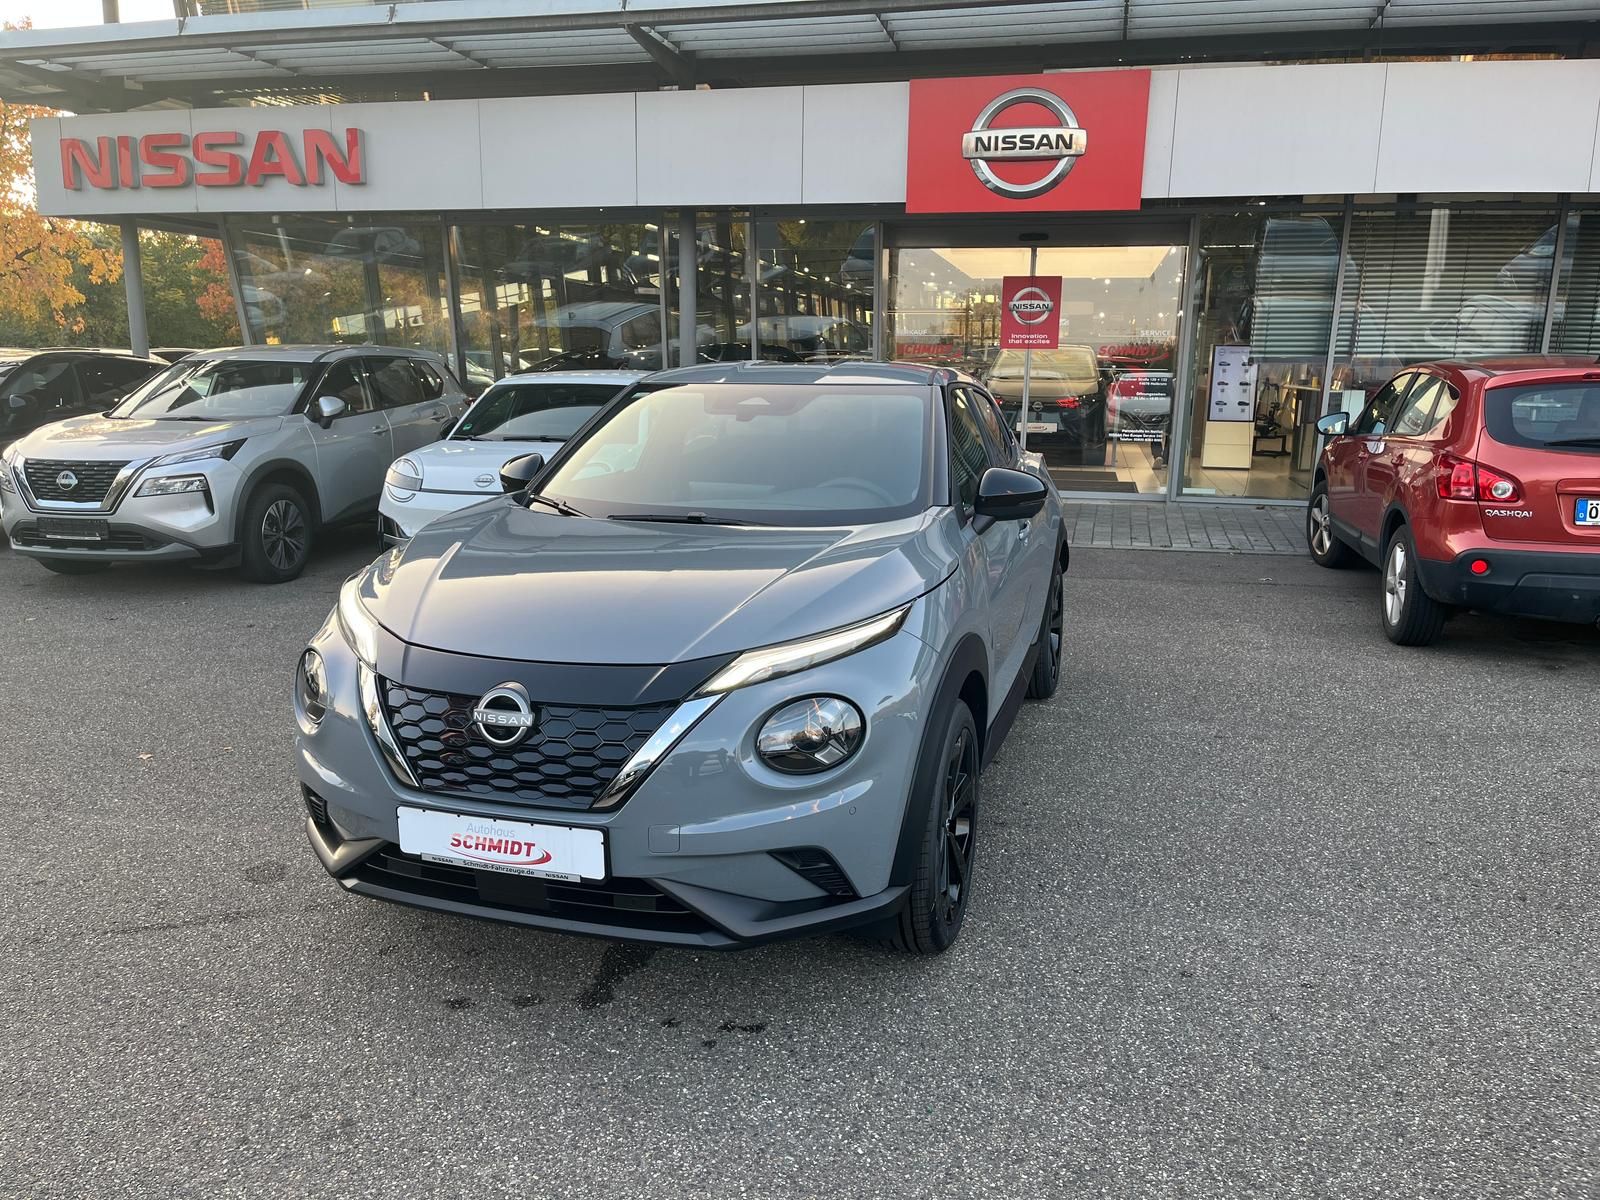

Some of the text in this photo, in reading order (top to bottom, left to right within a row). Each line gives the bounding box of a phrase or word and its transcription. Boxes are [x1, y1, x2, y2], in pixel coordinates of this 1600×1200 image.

[975, 134, 1073, 152] NISSAN
[60, 127, 366, 190] NISSAN
[1485, 509, 1532, 518] QASHQAI
[474, 711, 531, 725] NISSAN
[466, 823, 516, 838] Autohaus
[450, 832, 536, 857] SCHMIDT
[431, 856, 569, 880] NISSAN Schmidt-Fahrzeuge.de NISSAN
